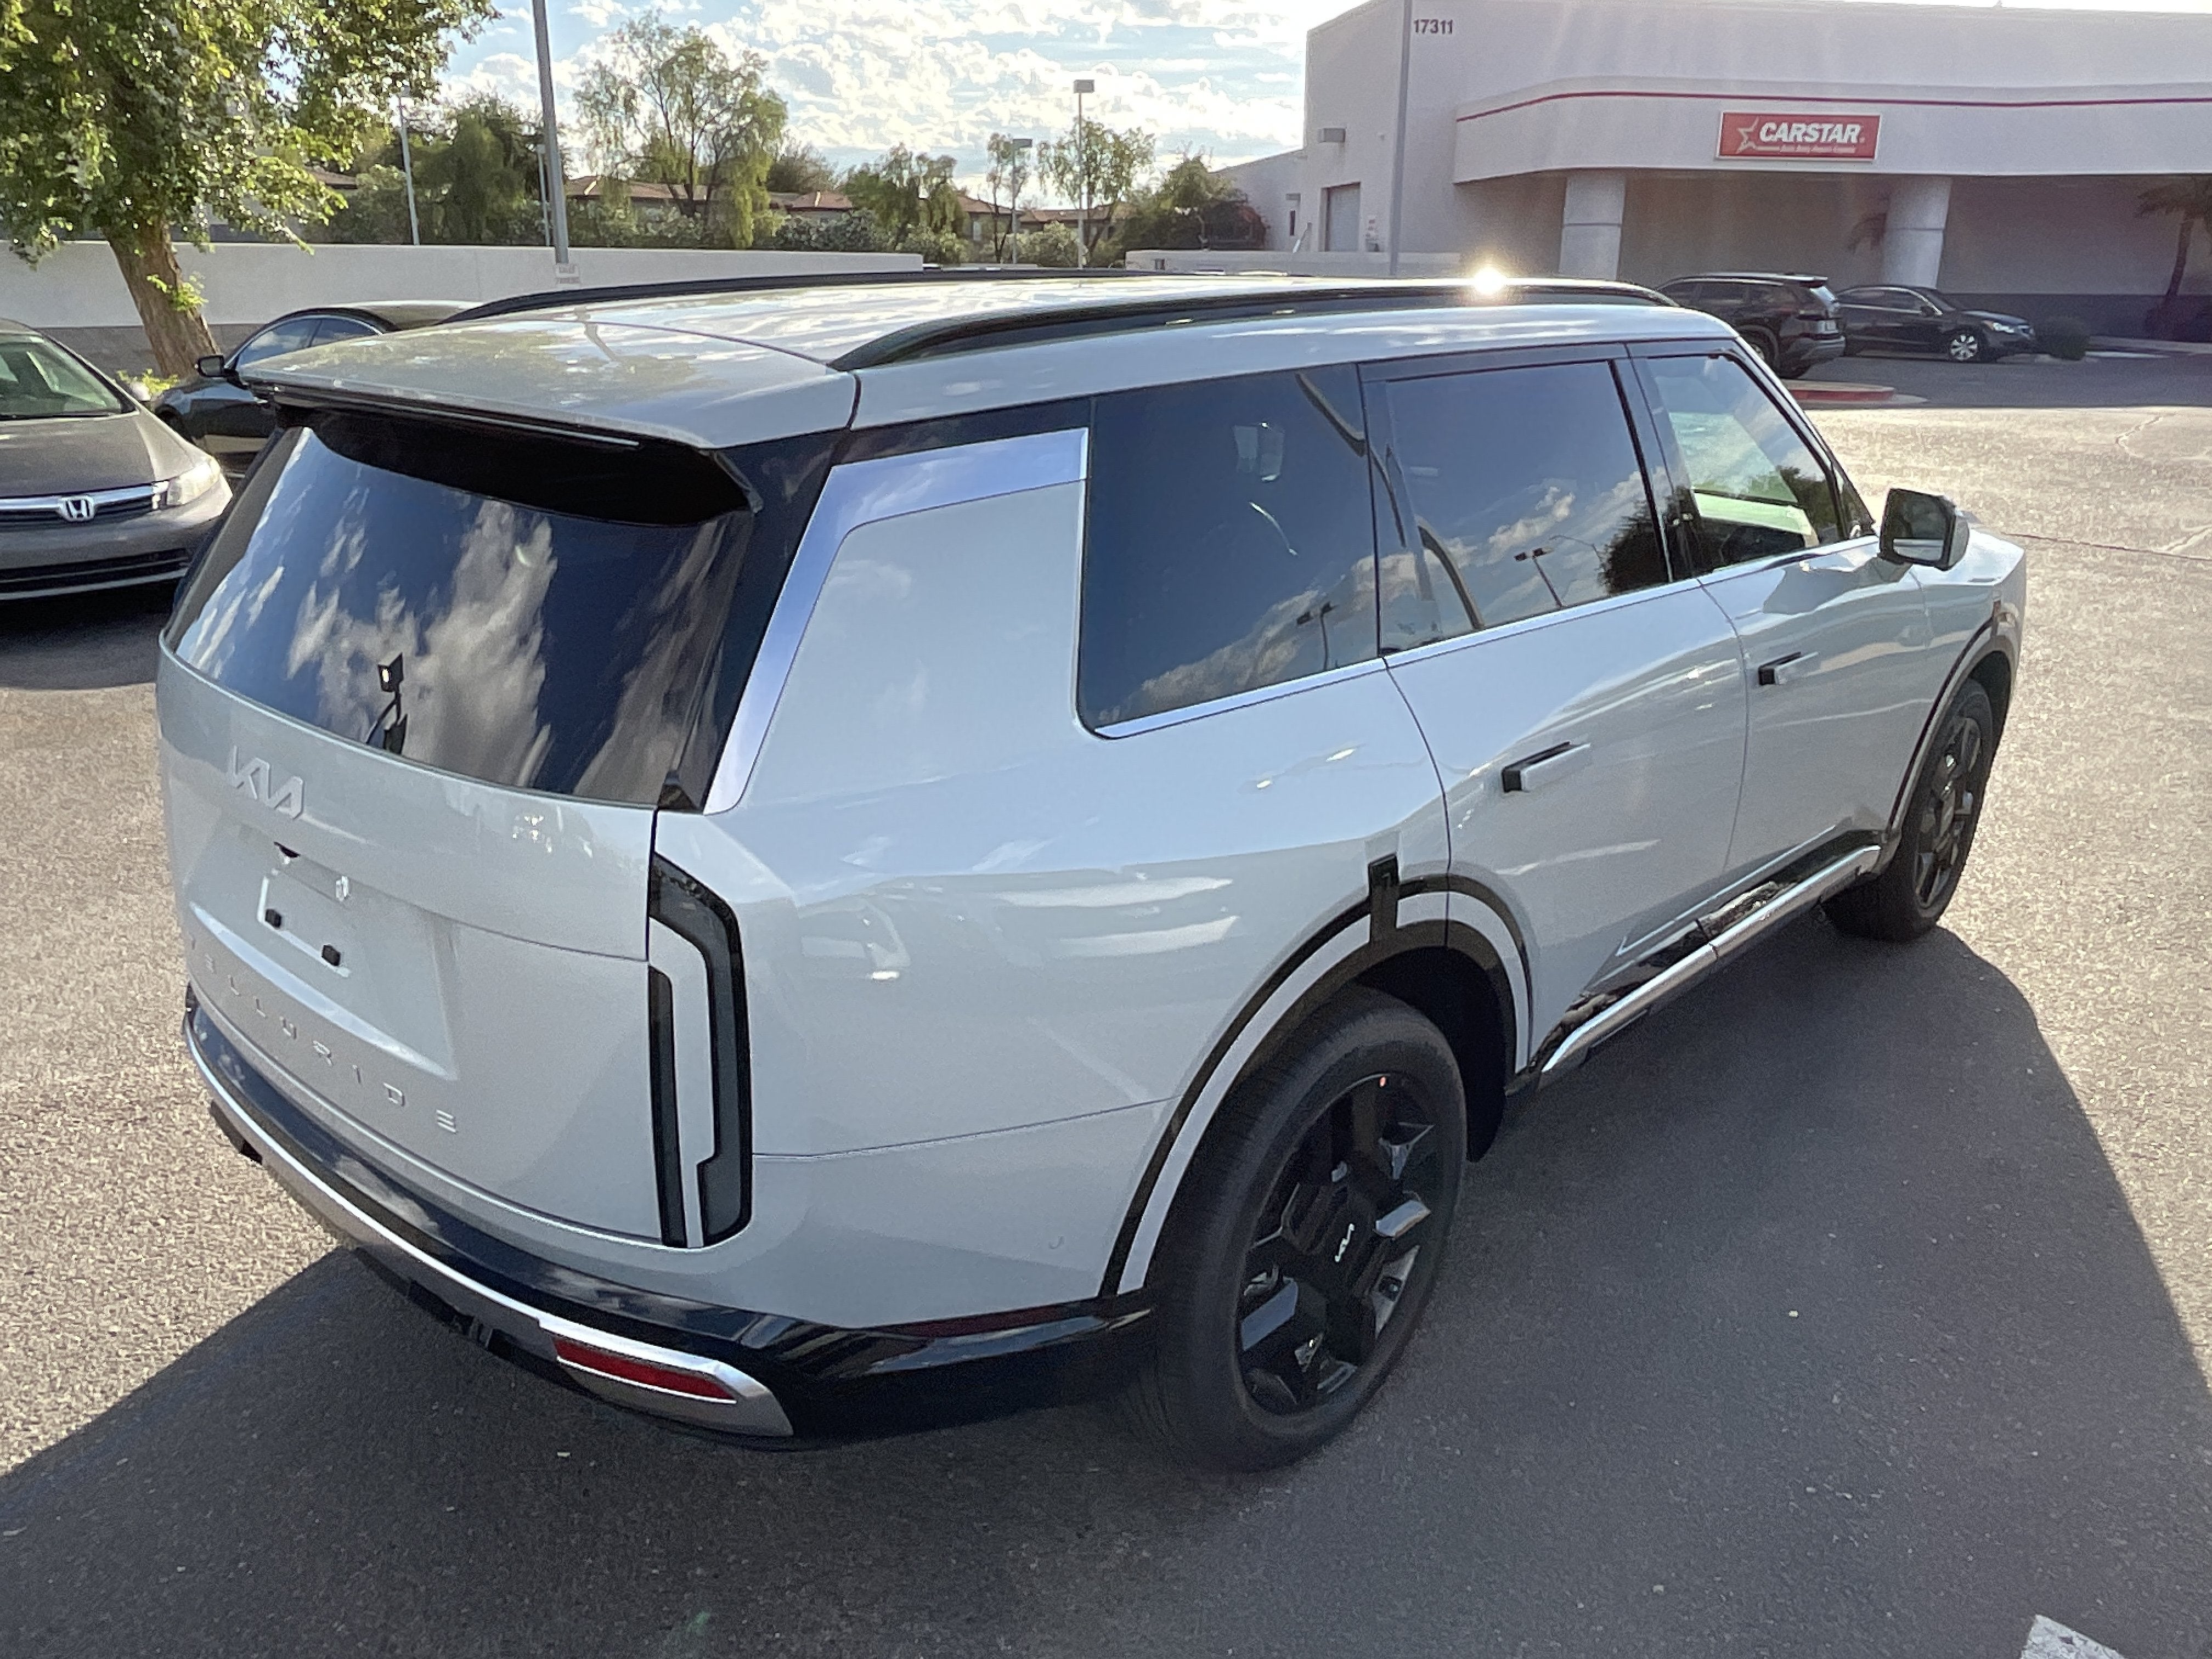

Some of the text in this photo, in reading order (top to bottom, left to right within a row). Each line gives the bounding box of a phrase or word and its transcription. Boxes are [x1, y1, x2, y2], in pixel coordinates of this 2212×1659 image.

[1414, 19, 1453, 34] 17311
[1760, 122, 1861, 143] CARSTAR
[228, 745, 305, 821] KIA
